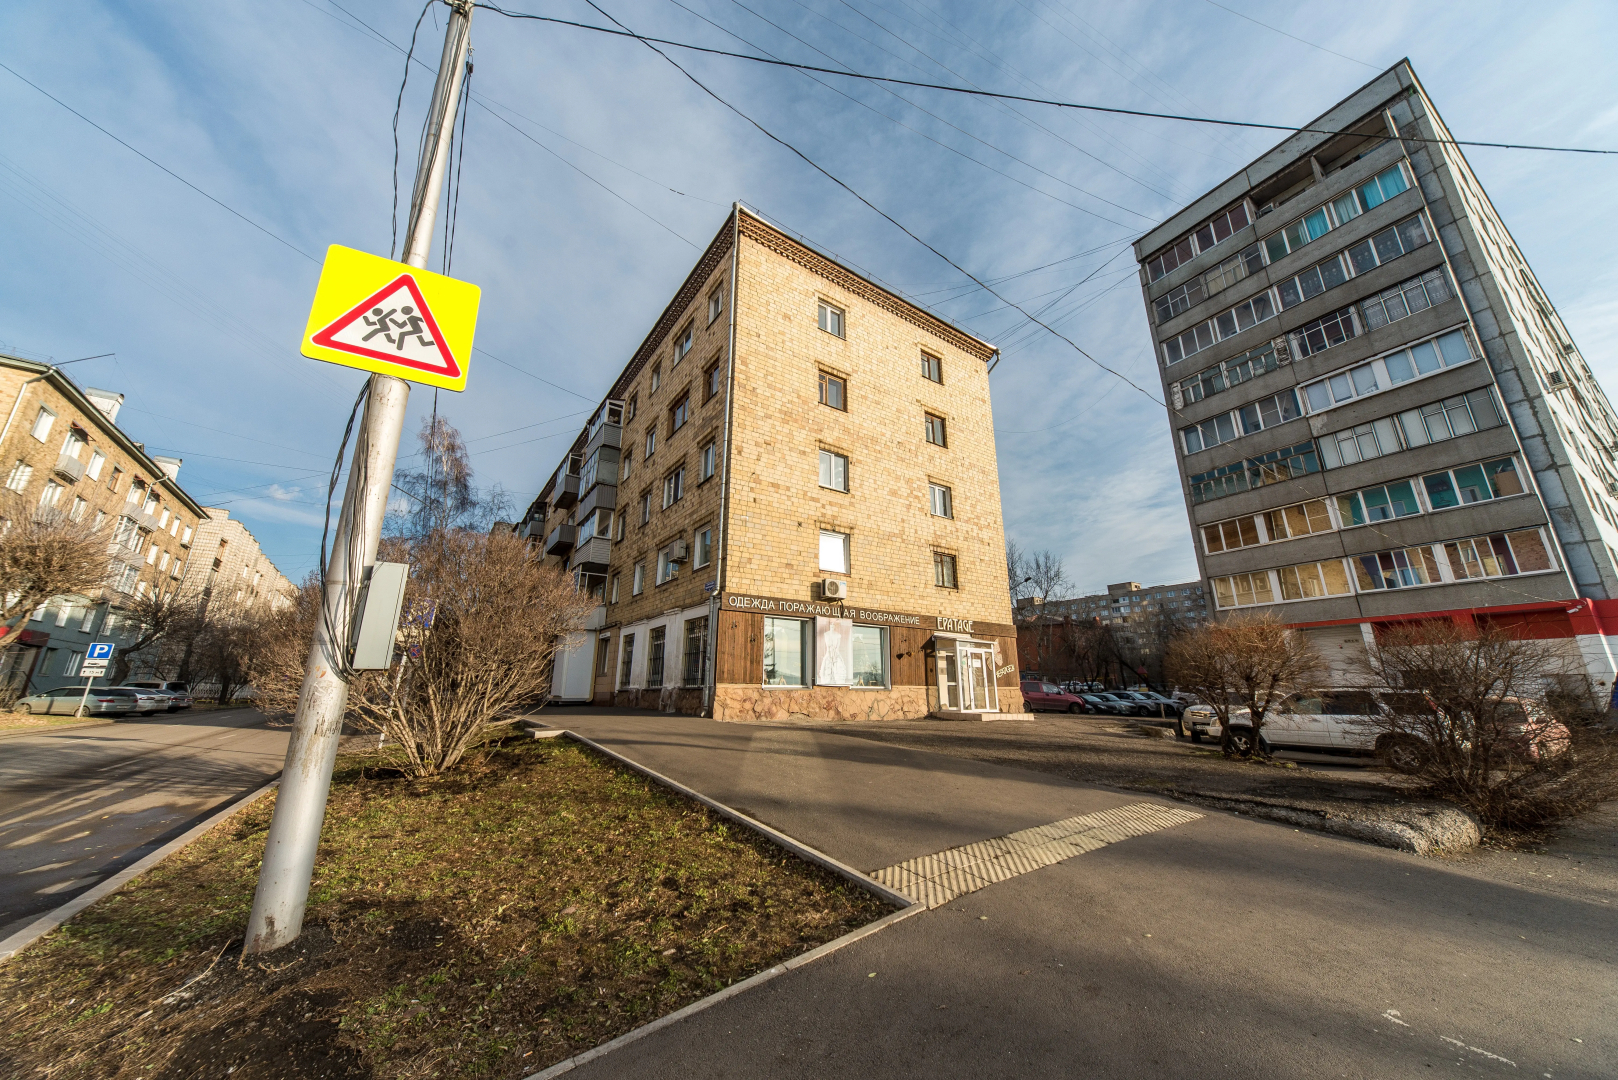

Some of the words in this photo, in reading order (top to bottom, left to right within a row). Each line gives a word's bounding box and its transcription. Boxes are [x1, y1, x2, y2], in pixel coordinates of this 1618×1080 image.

[728, 596, 775, 611] ОДЕЖДА
[779, 601, 856, 618] ПОРАЖАЮЩАЯ
[860, 610, 920, 625] ВООБРАЖЕНИЕ
[937, 616, 975, 633] EPATAGE
[93, 645, 108, 657] P
